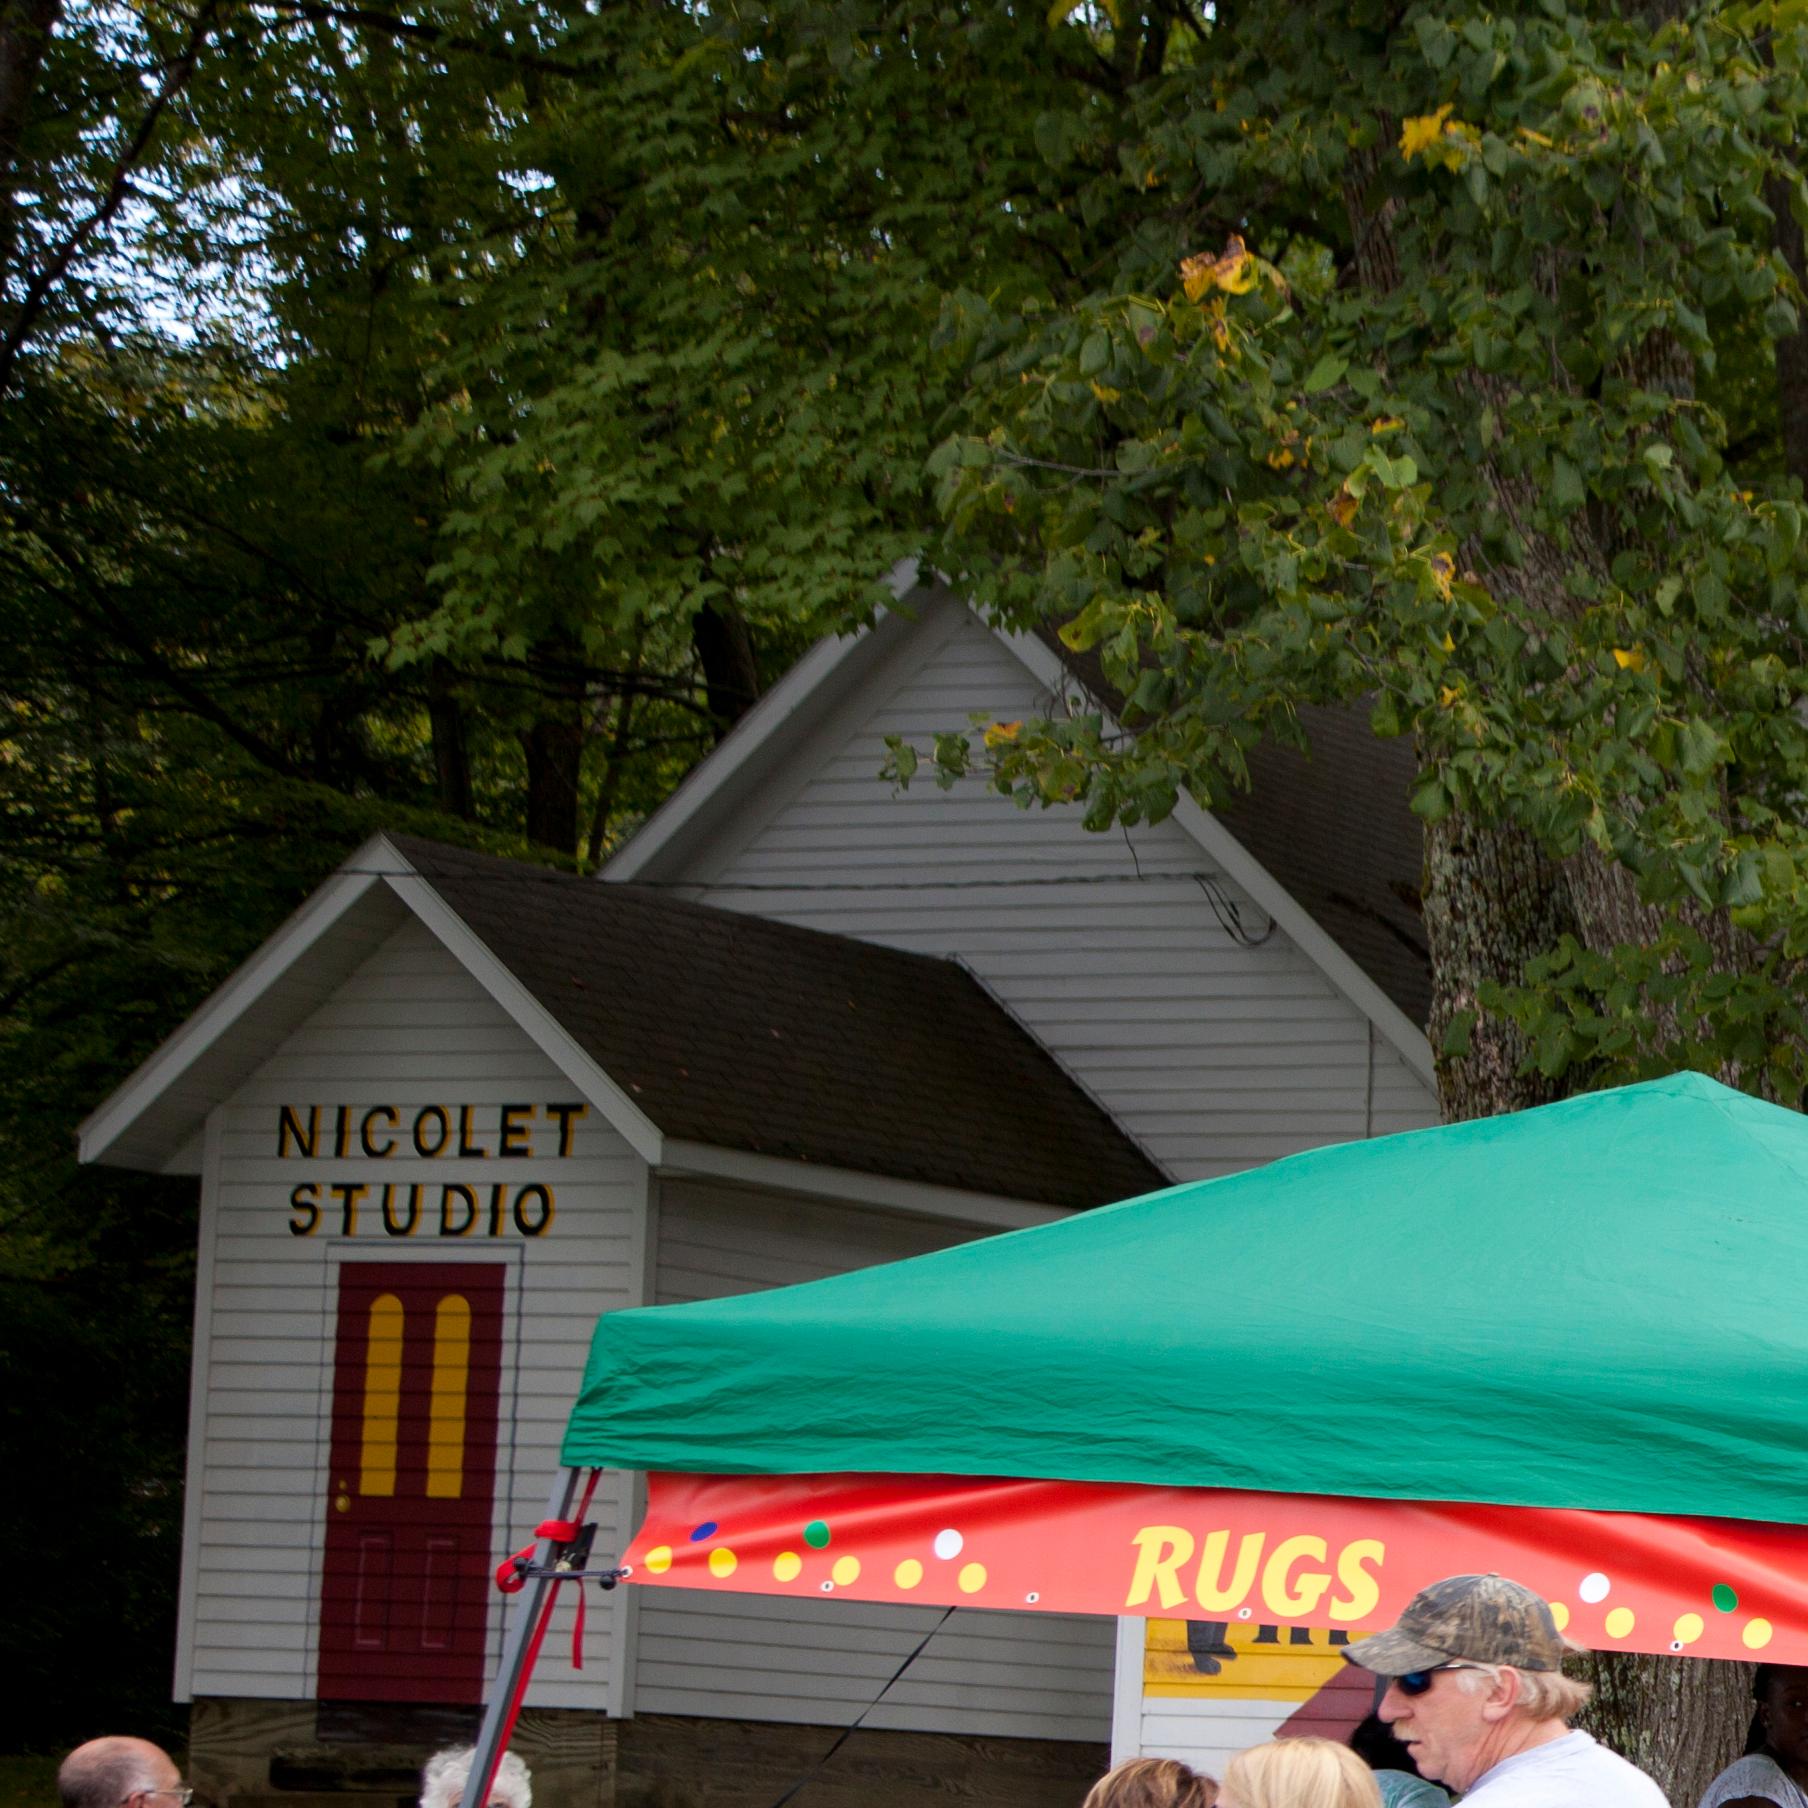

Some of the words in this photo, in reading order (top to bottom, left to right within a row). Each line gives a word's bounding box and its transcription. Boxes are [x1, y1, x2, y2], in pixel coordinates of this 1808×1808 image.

[277, 1103, 590, 1159] NICOLET
[288, 1182, 556, 1237] STUDIO
[1124, 1524, 1386, 1622] RUGS
